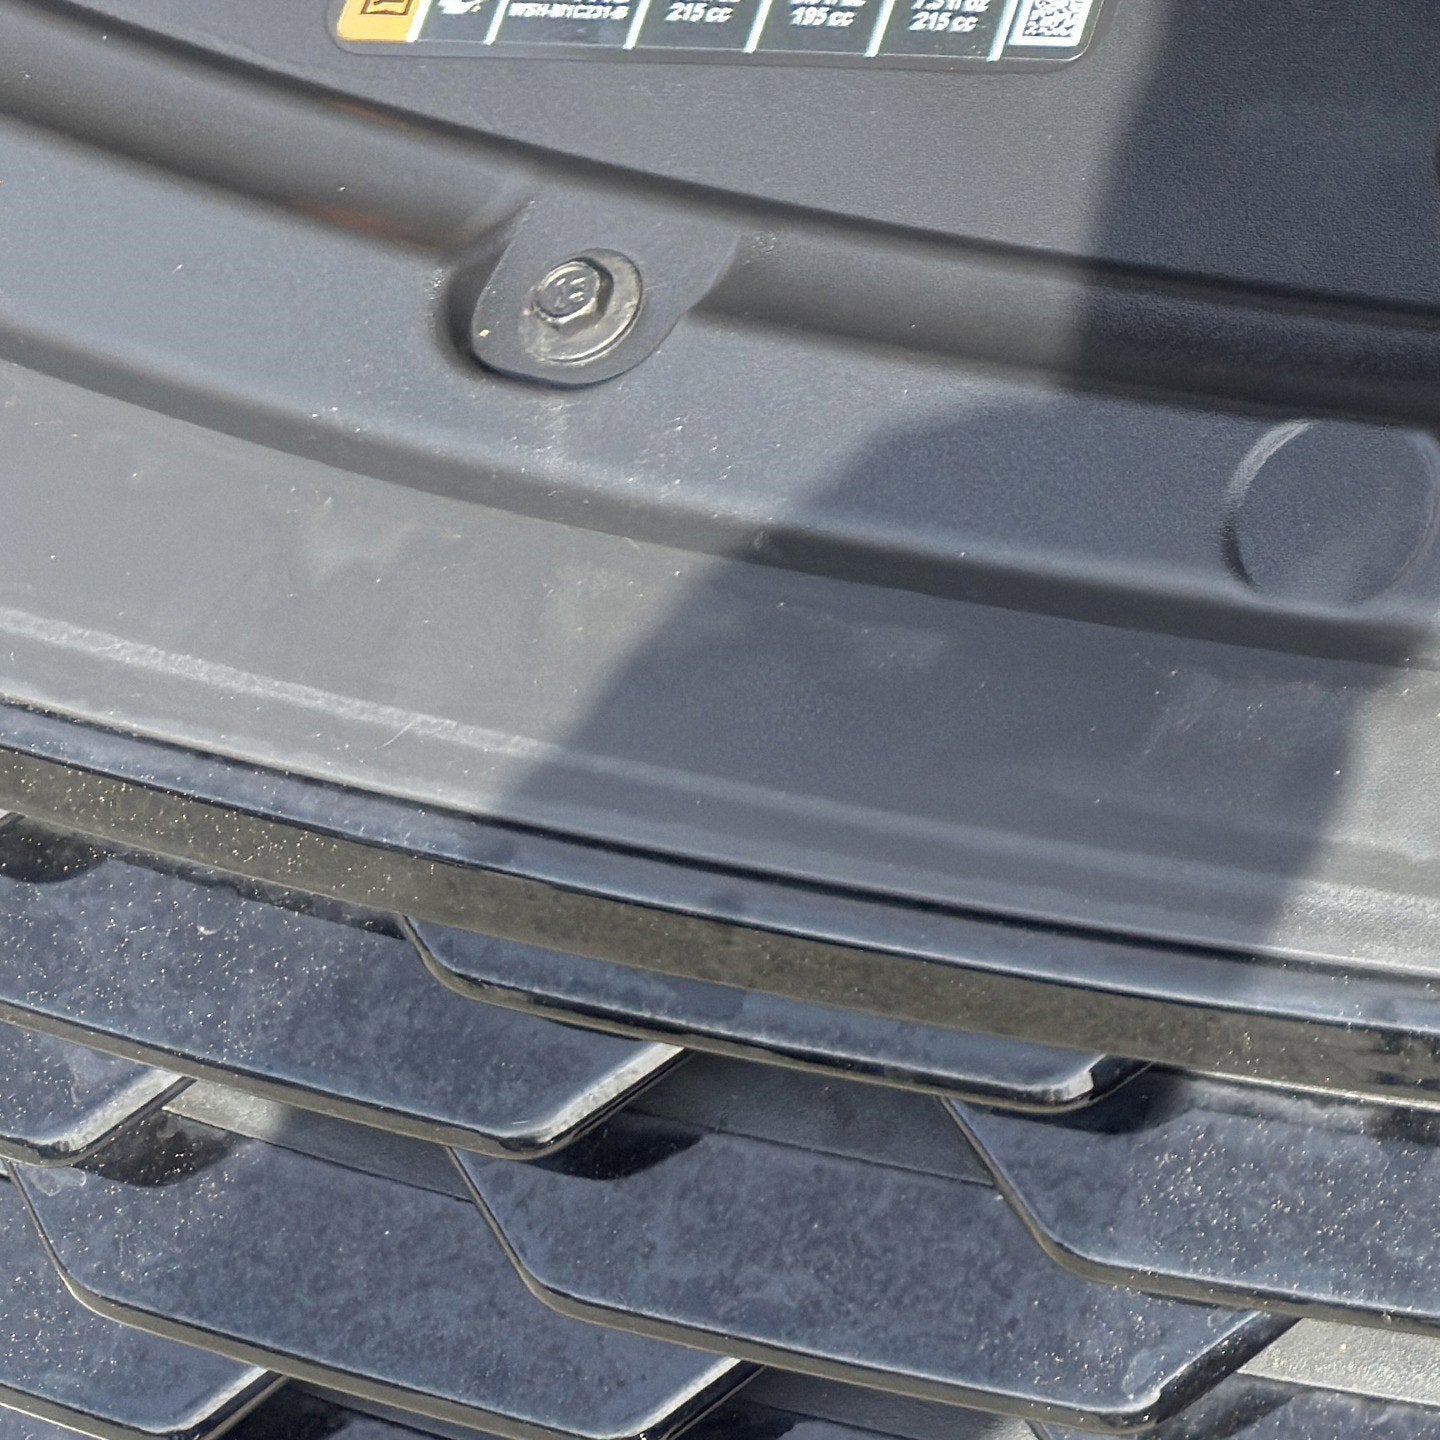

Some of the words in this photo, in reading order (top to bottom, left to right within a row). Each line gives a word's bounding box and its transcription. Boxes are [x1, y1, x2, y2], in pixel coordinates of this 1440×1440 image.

[665, 2, 707, 21] 215
[705, 7, 734, 23] cc
[789, 6, 829, 25] 195
[828, 10, 857, 27] cc
[908, 11, 951, 31] 215
[950, 16, 979, 32] cc
